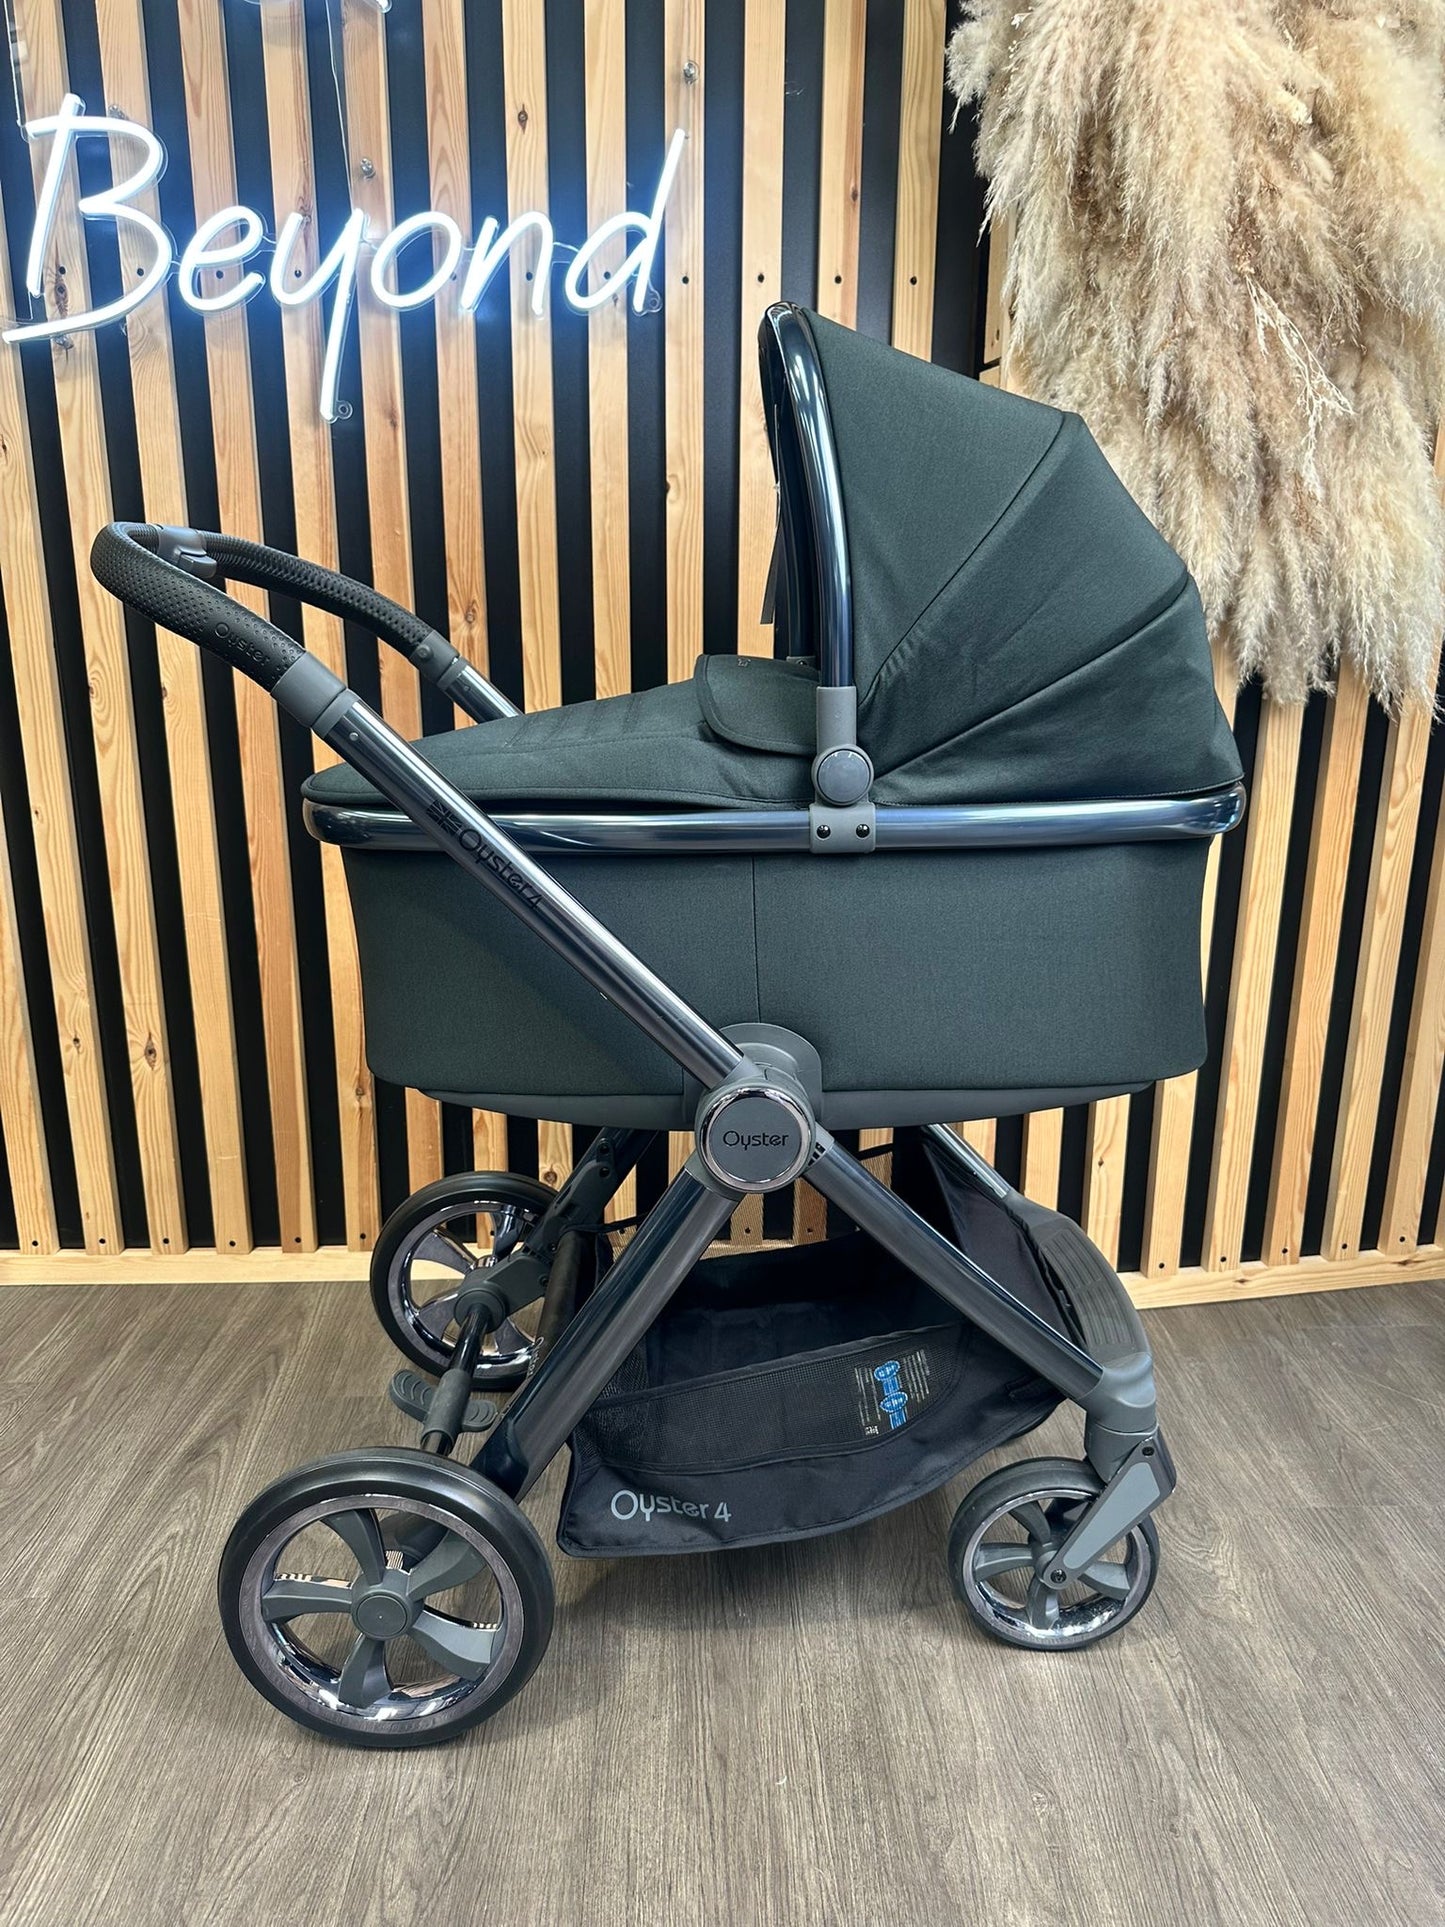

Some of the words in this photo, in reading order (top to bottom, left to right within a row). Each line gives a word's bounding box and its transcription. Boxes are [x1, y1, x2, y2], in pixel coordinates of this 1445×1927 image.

[2, 93, 686, 422] Beyond
[214, 621, 271, 667] Oyster
[722, 1130, 789, 1151] Oyster
[610, 1489, 709, 1522] Oyster
[713, 1502, 732, 1522] 4
